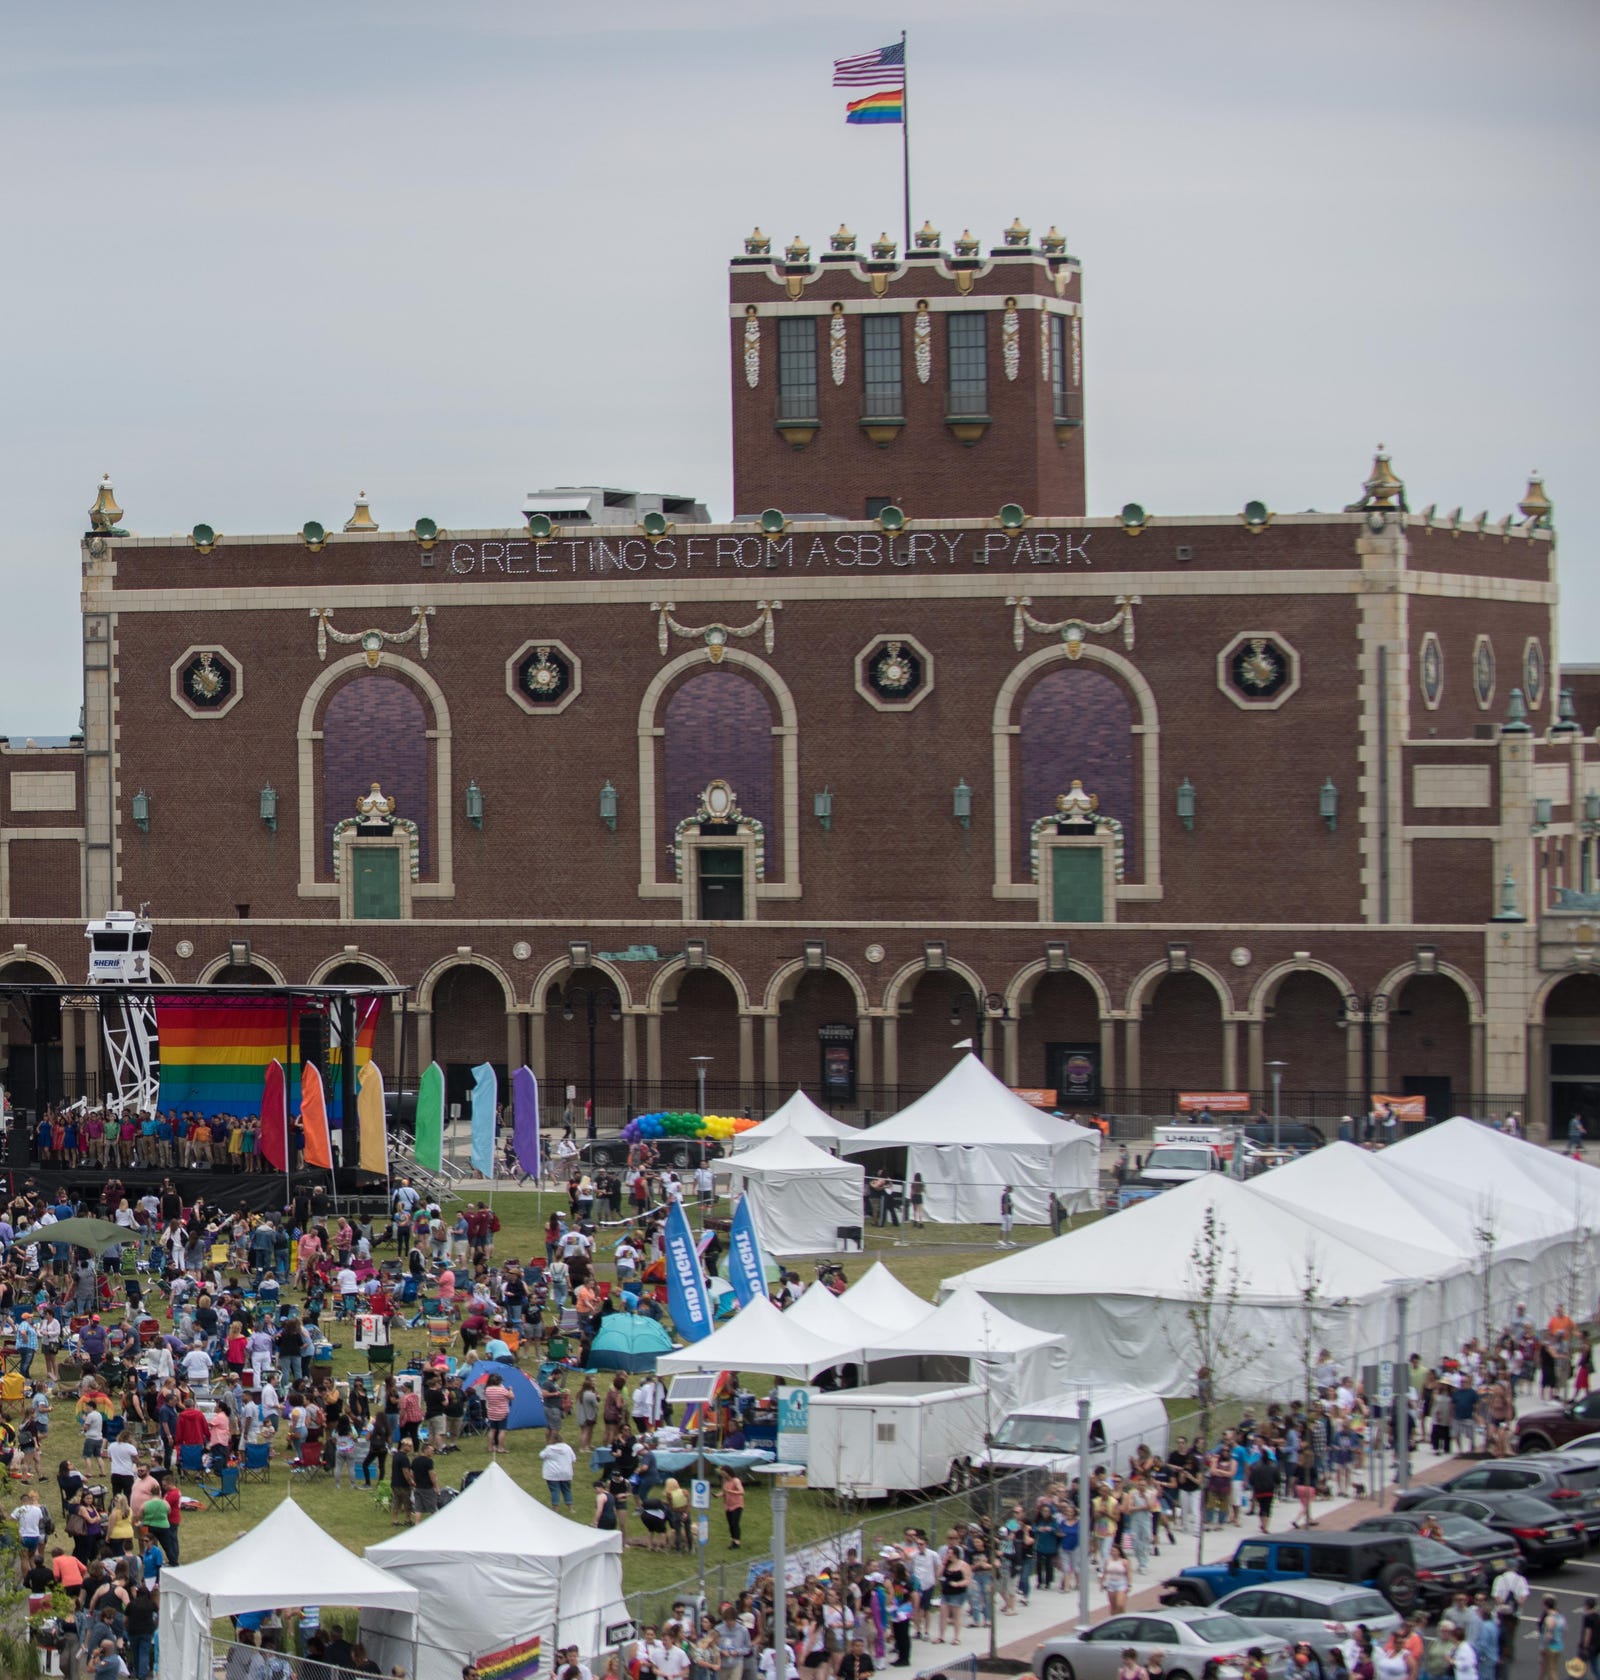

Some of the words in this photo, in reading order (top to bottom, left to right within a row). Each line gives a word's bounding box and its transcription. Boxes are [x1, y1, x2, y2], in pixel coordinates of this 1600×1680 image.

[452, 538, 677, 574] GREETINGS
[686, 537, 793, 569] FROM
[806, 533, 964, 567] ASBURY
[984, 533, 1092, 565] PARK
[93, 959, 125, 967] SHERIF
